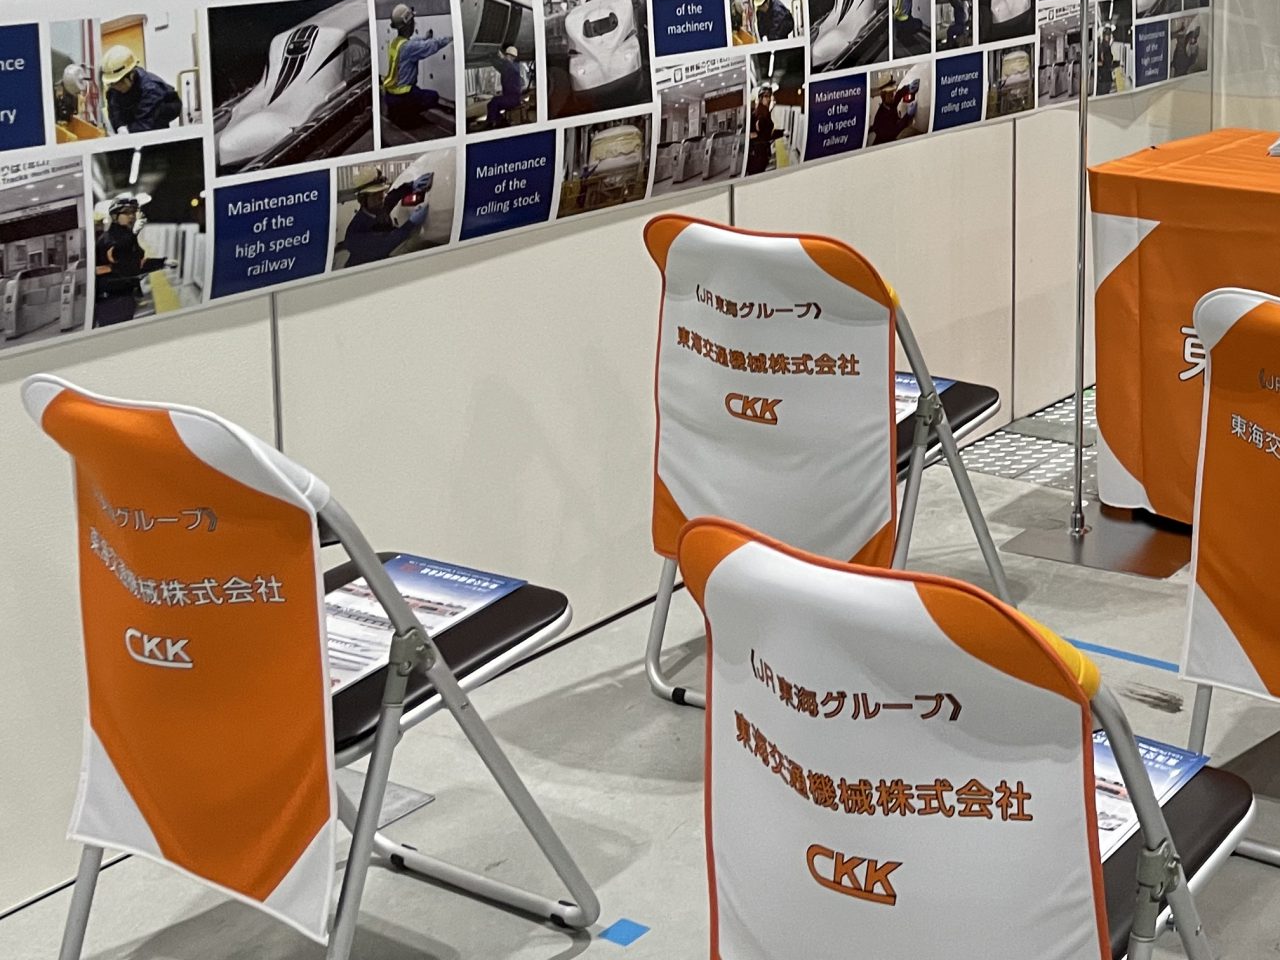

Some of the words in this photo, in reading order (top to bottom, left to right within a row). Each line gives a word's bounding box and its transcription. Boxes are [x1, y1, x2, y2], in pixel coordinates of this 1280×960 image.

[676, 3, 686, 16] of
[687, 2, 702, 15] the
[667, 18, 713, 35] machinery
[940, 69, 979, 86] Maintenance
[815, 86, 861, 104] Maintenance
[951, 88, 958, 98] of
[958, 86, 968, 96] the
[827, 104, 835, 116] of
[837, 103, 848, 114] the
[941, 102, 960, 115] rolling
[961, 99, 976, 111] stock
[818, 122, 832, 135] high
[835, 117, 856, 131] speed
[823, 134, 848, 147] railway
[476, 155, 546, 179] Maintenance
[495, 180, 506, 194] of
[508, 177, 526, 191] the
[227, 188, 318, 217] Maintenance
[475, 200, 510, 217] rolling
[513, 192, 541, 208] stock
[253, 218, 267, 234] of
[270, 214, 294, 230] the
[235, 240, 265, 259] high
[269, 230, 310, 252] speed
[247, 256, 296, 277] railway
[677, 326, 860, 377] 東海交通機械株式会社
[725, 392, 783, 425] CKK
[124, 627, 193, 669] CKK
[734, 709, 1034, 821] 東海交通機械株式会社
[806, 844, 903, 907] CKK
